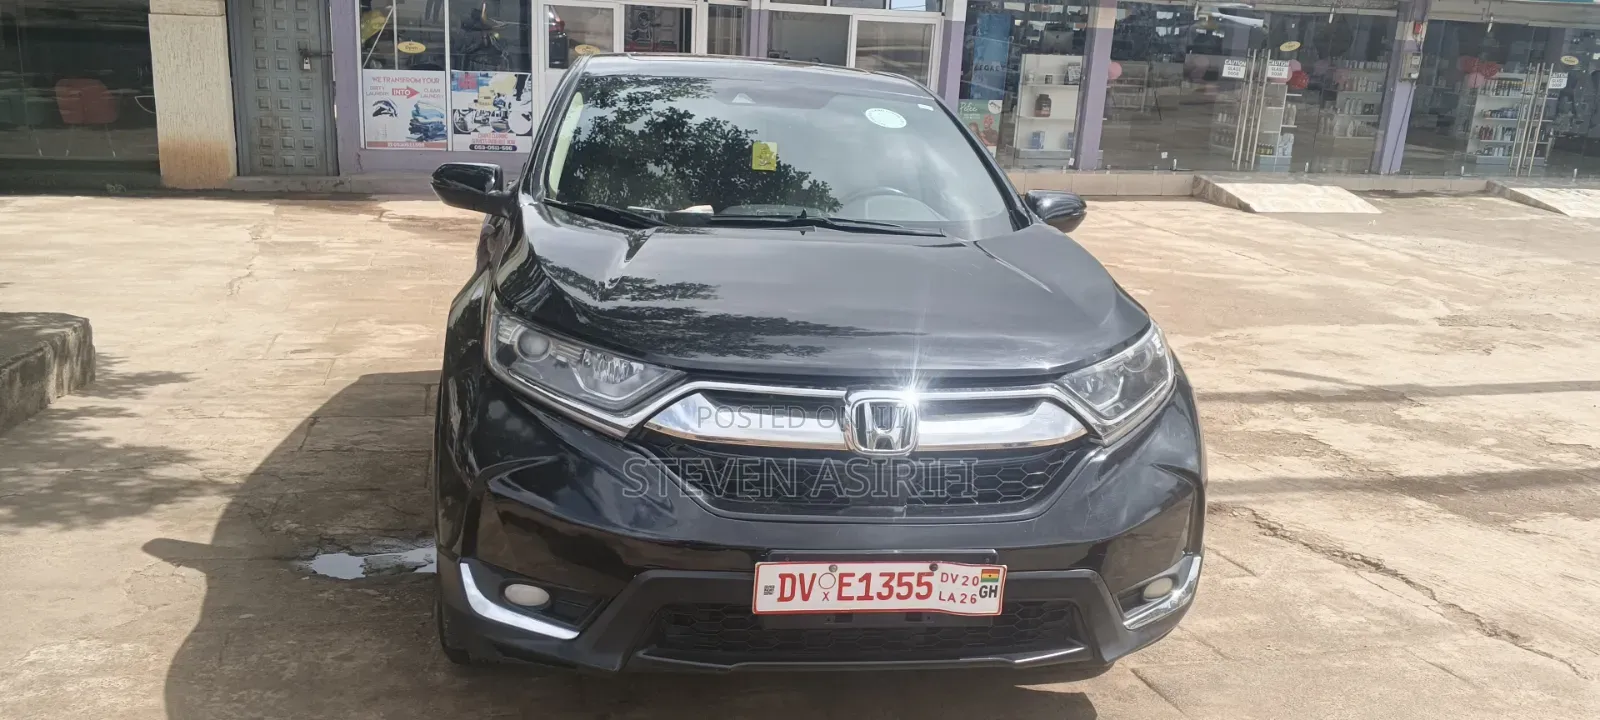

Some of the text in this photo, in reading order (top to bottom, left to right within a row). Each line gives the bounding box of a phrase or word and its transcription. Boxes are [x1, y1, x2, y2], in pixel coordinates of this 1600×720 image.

[777, 572, 933, 602] DV E1355
[978, 585, 998, 599] GH
[822, 592, 830, 602] X
